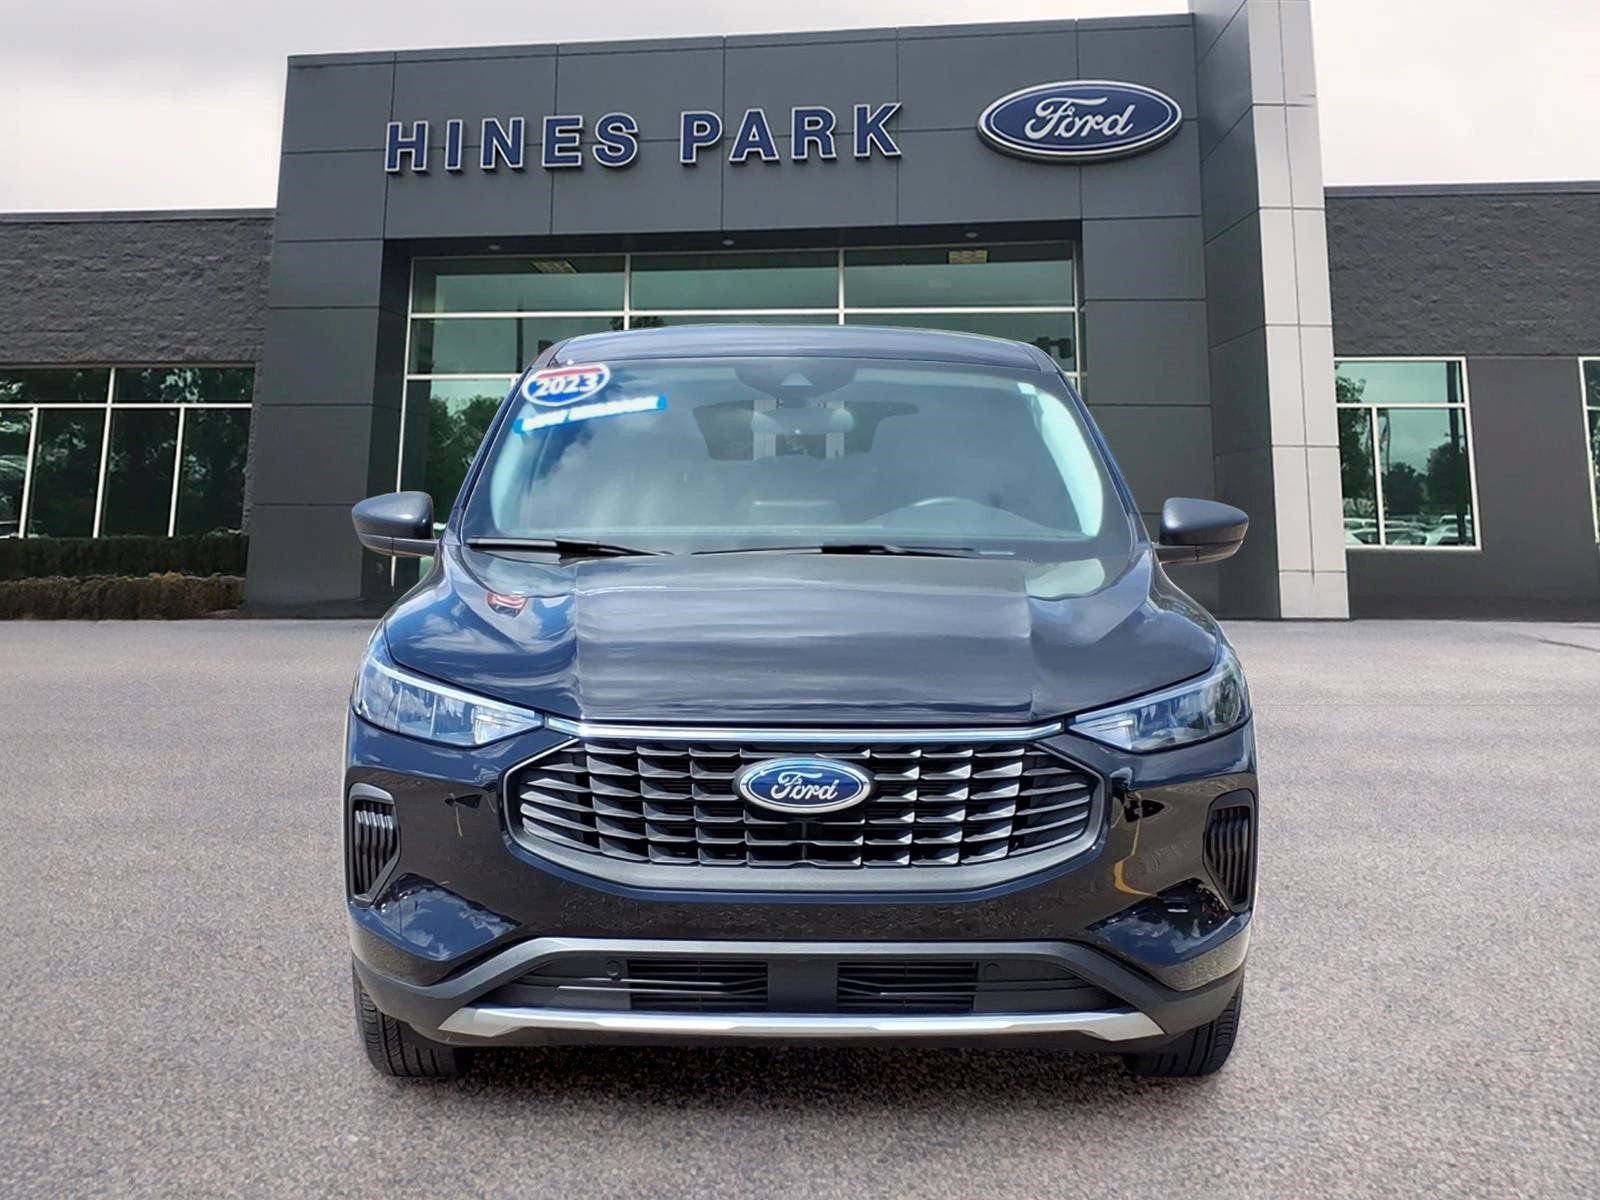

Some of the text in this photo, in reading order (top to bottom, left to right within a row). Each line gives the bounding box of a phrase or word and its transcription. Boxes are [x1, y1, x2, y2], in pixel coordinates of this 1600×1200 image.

[1024, 97, 1136, 140] Ford
[385, 102, 903, 172] HINES PARK
[533, 374, 599, 397] 2023
[770, 771, 840, 800] Ford
